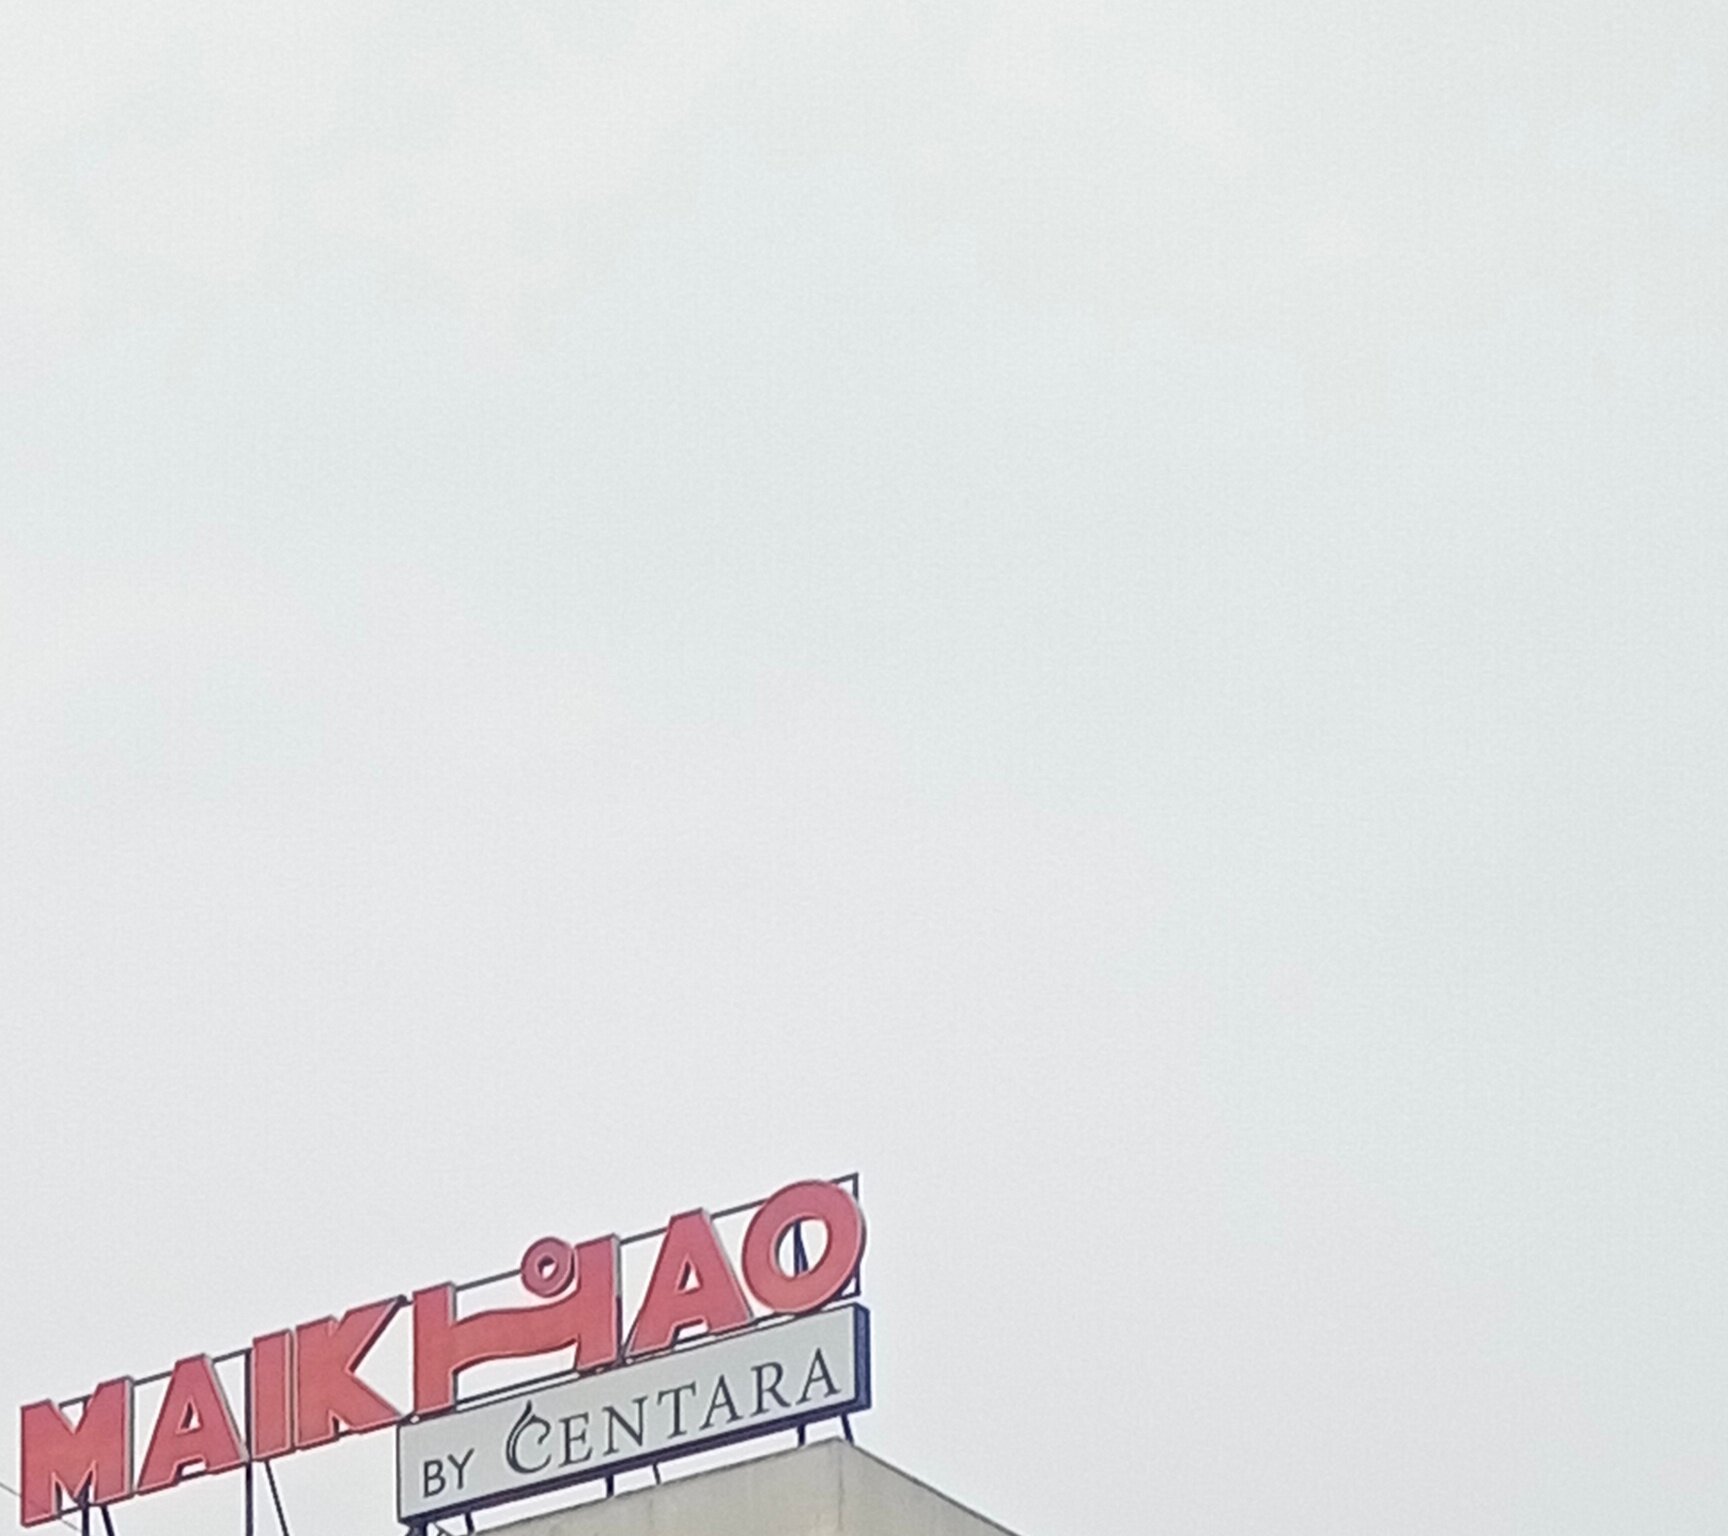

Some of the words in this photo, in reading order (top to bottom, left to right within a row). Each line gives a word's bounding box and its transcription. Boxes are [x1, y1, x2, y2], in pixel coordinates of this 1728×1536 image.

[20, 1179, 866, 1527] MAIKHAO
[422, 1449, 475, 1500] BY
[505, 1347, 842, 1476] CENTARA
